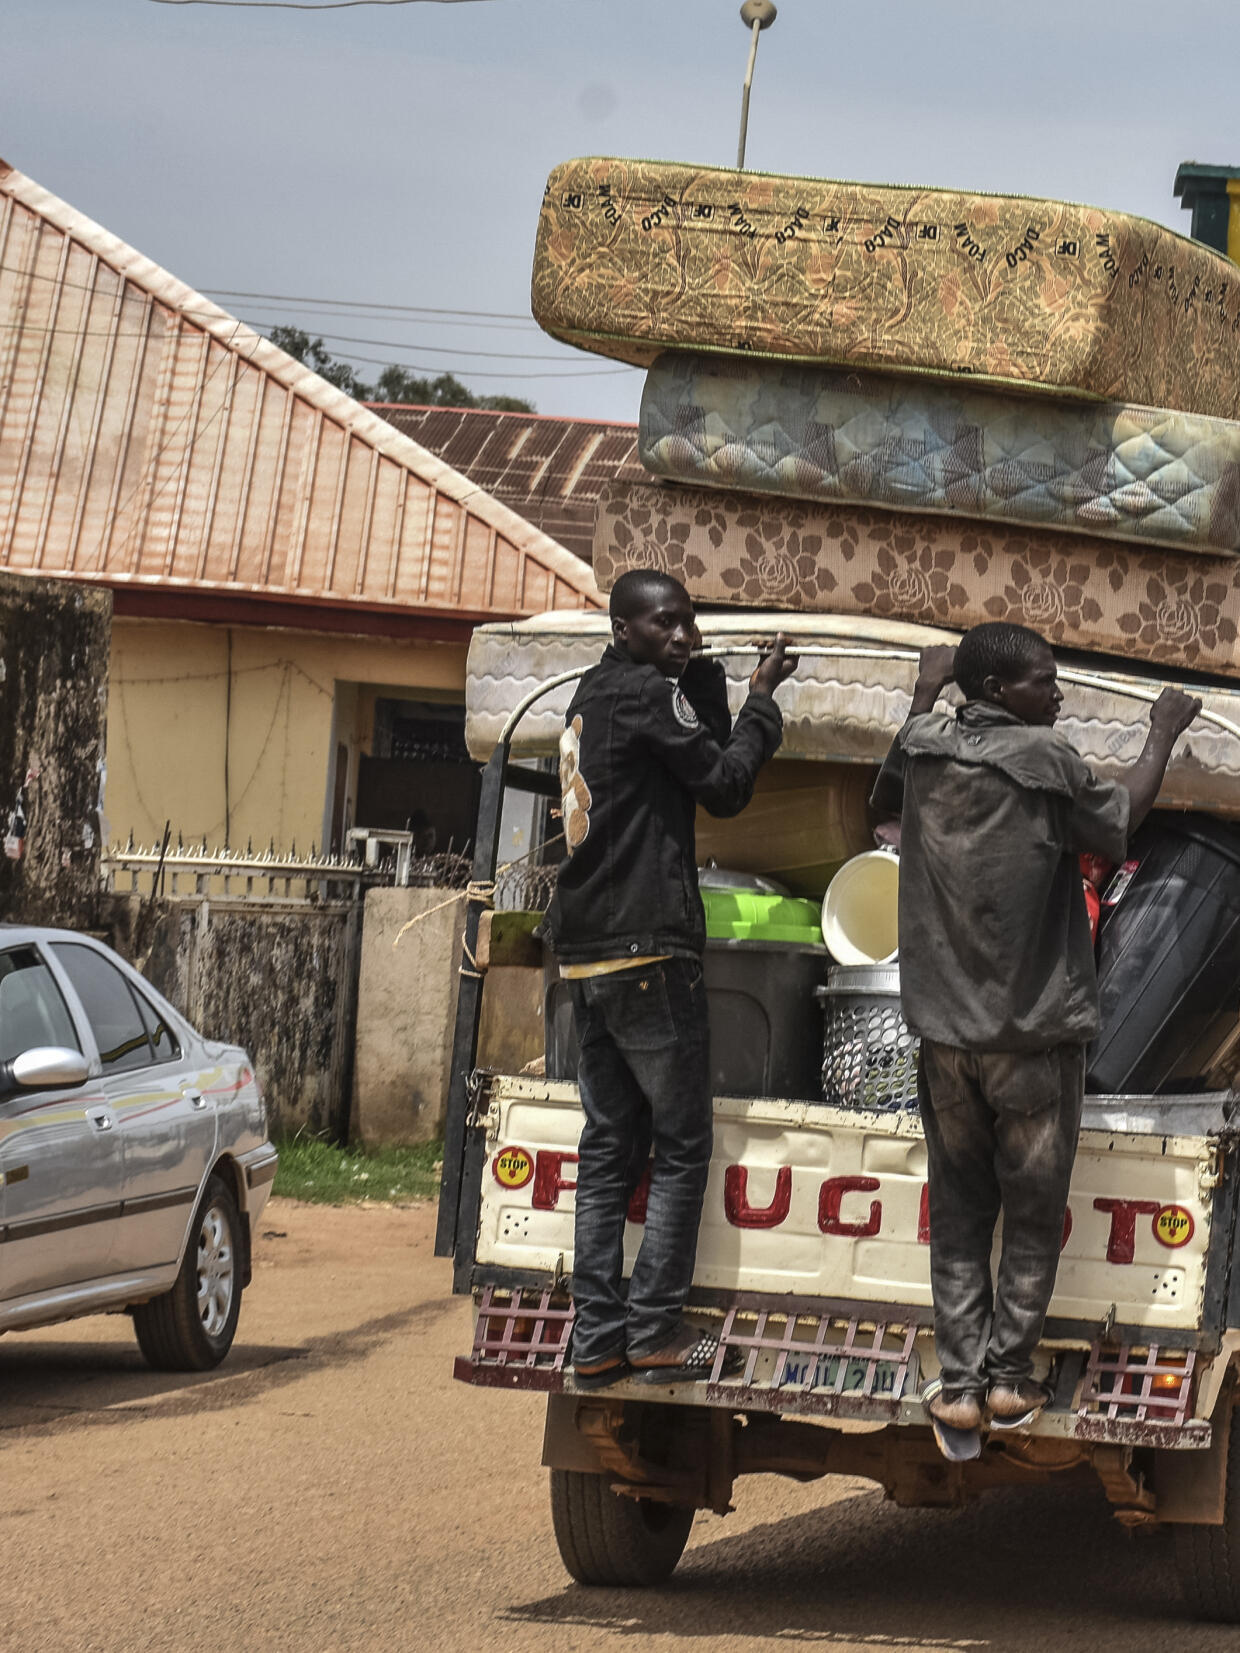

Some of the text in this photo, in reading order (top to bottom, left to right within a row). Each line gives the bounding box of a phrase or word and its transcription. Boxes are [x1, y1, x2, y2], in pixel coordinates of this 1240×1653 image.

[562, 193, 582, 209] DF
[598, 184, 622, 226] FOAM
[641, 193, 677, 232] DACO
[693, 204, 713, 219] DF
[775, 207, 810, 244] DACO
[864, 216, 901, 253] DACO
[918, 224, 938, 240] DF
[954, 222, 1040, 268] DACO FOAM
[1057, 241, 1077, 256] DF
[1096, 233, 1120, 279] FOAM
[500, 1157, 528, 1171] STOP
[1159, 1215, 1188, 1230] STOP
